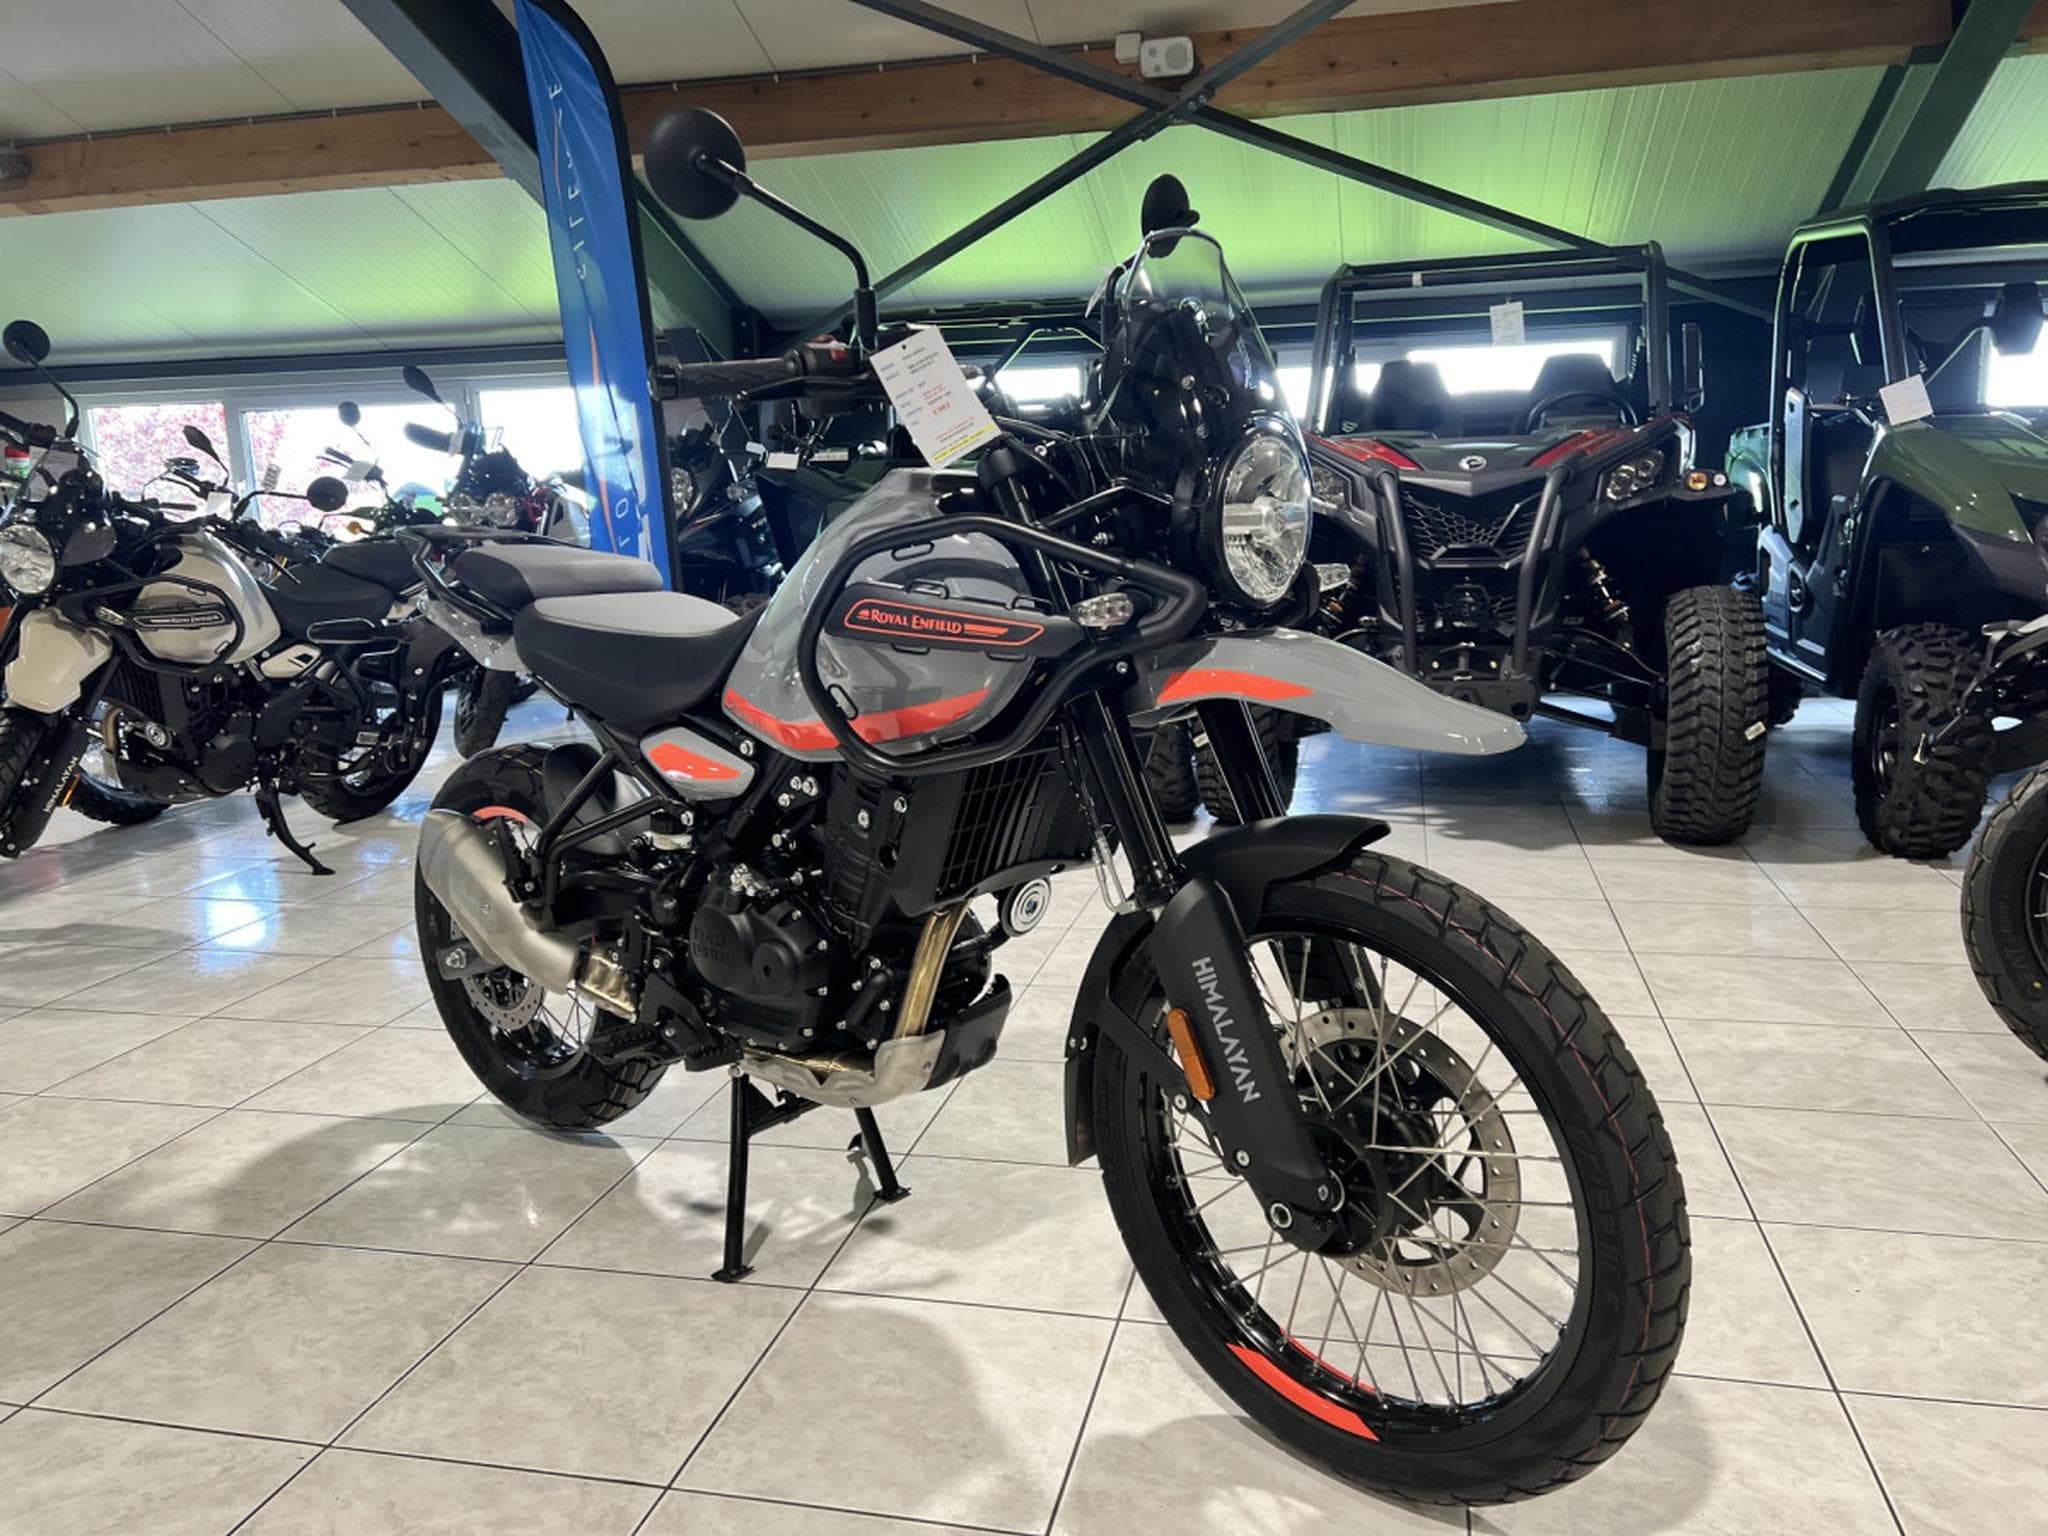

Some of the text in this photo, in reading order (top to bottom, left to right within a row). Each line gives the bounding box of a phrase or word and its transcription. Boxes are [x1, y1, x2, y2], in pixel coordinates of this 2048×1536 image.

[869, 608, 963, 634] ROYAL ENFIELD
[1191, 956, 1261, 1103] HIMALAYAN
